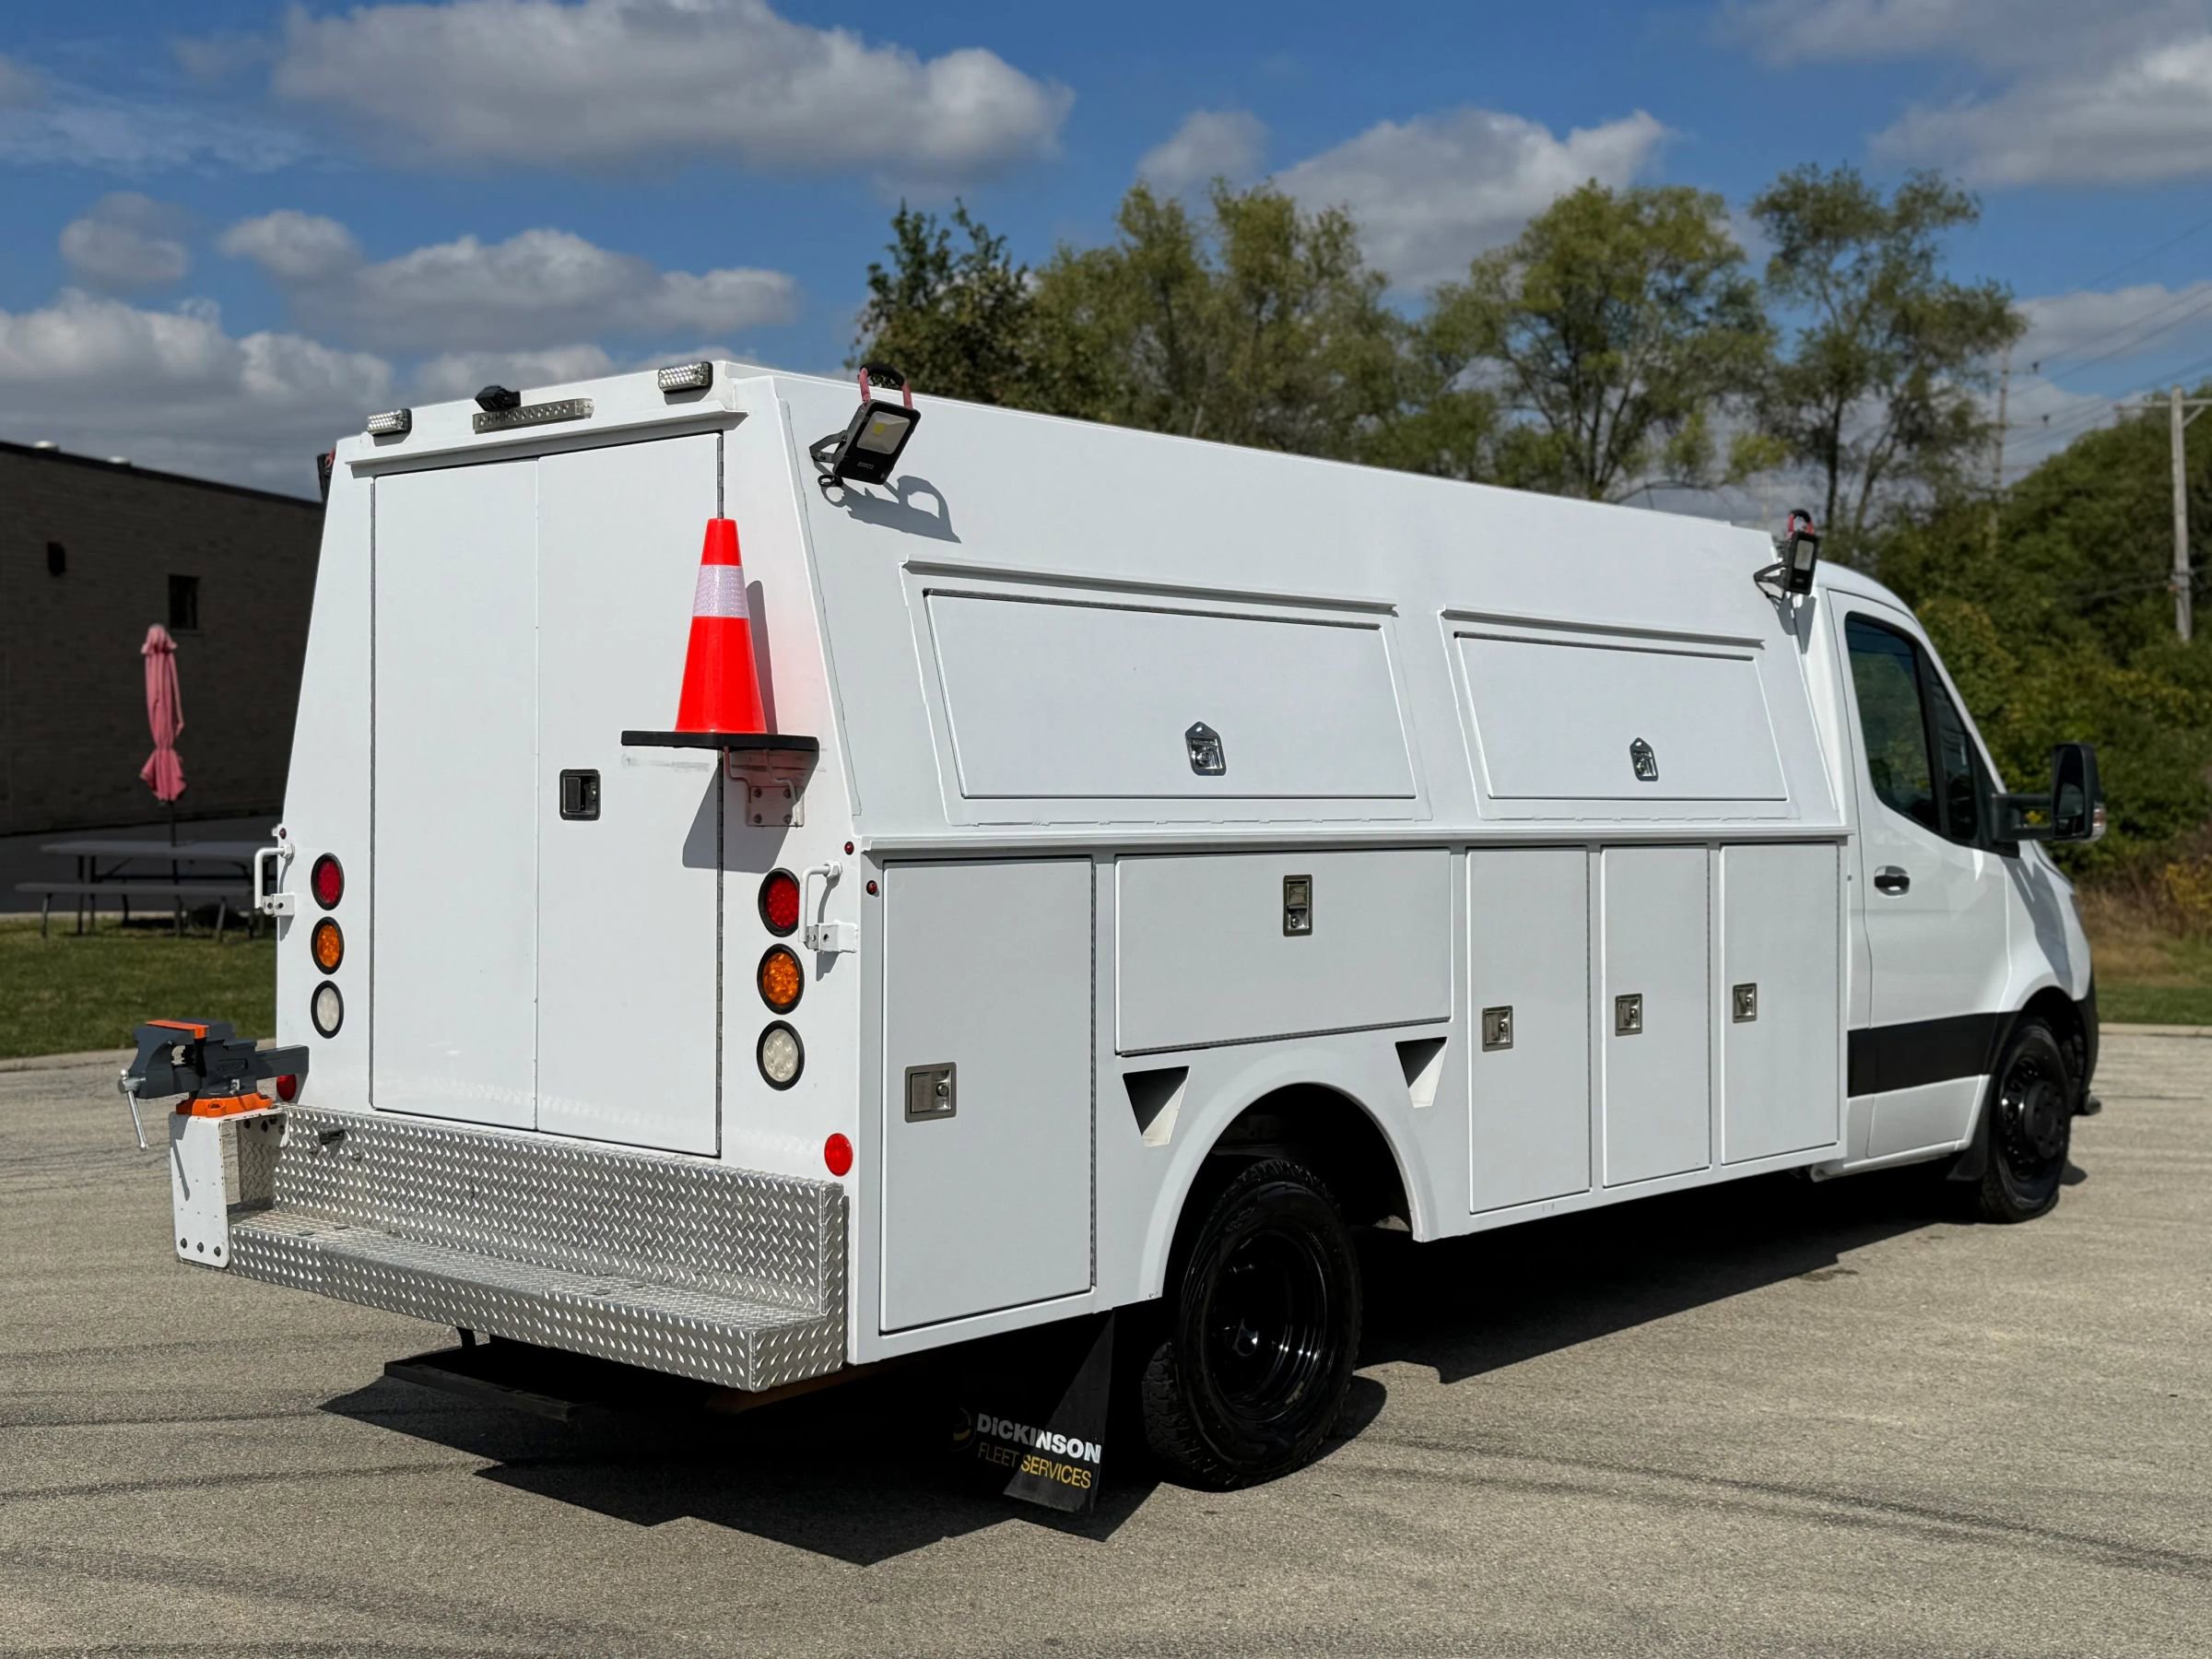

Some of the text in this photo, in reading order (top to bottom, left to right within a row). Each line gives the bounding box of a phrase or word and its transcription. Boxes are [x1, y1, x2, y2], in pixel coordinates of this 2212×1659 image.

[977, 1413, 1101, 1464] DICKINSON
[978, 1442, 1092, 1489] FLEET SERVICES
